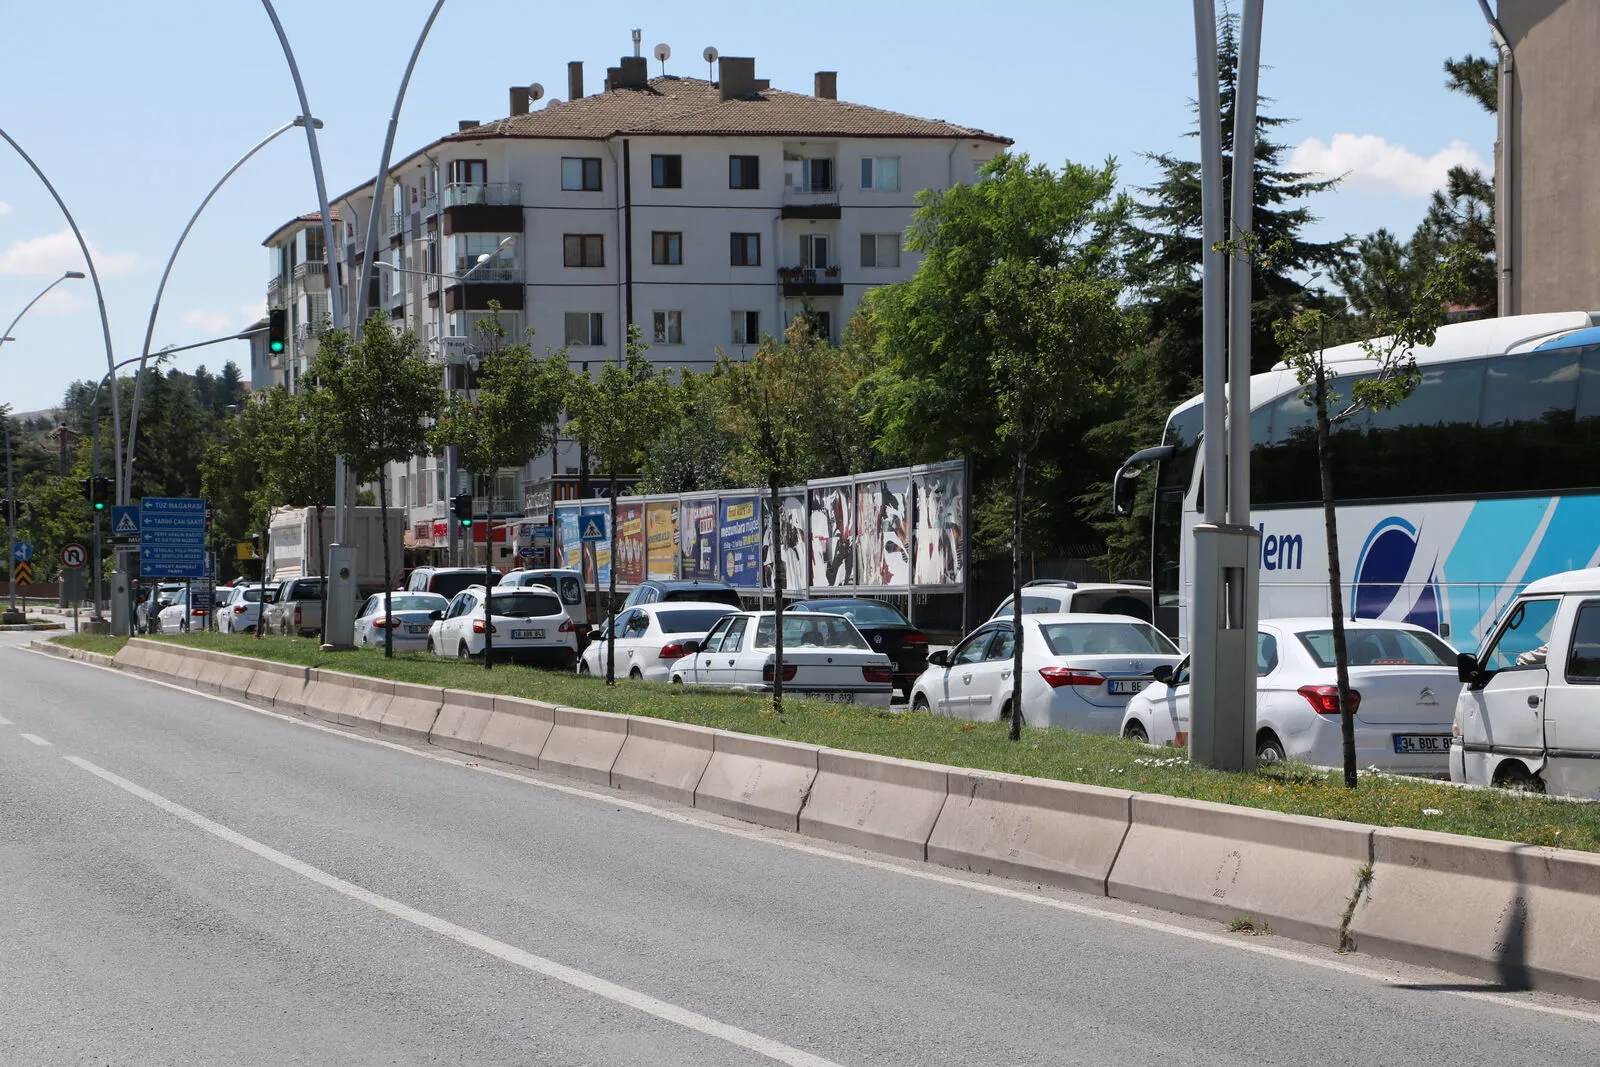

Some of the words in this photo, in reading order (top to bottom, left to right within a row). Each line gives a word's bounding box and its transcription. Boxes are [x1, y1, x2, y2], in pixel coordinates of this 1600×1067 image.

[1115, 681, 1124, 692] 71
[1131, 681, 1142, 692] BE
[1402, 737, 1415, 750] 34
[1419, 737, 1438, 750] BDC
